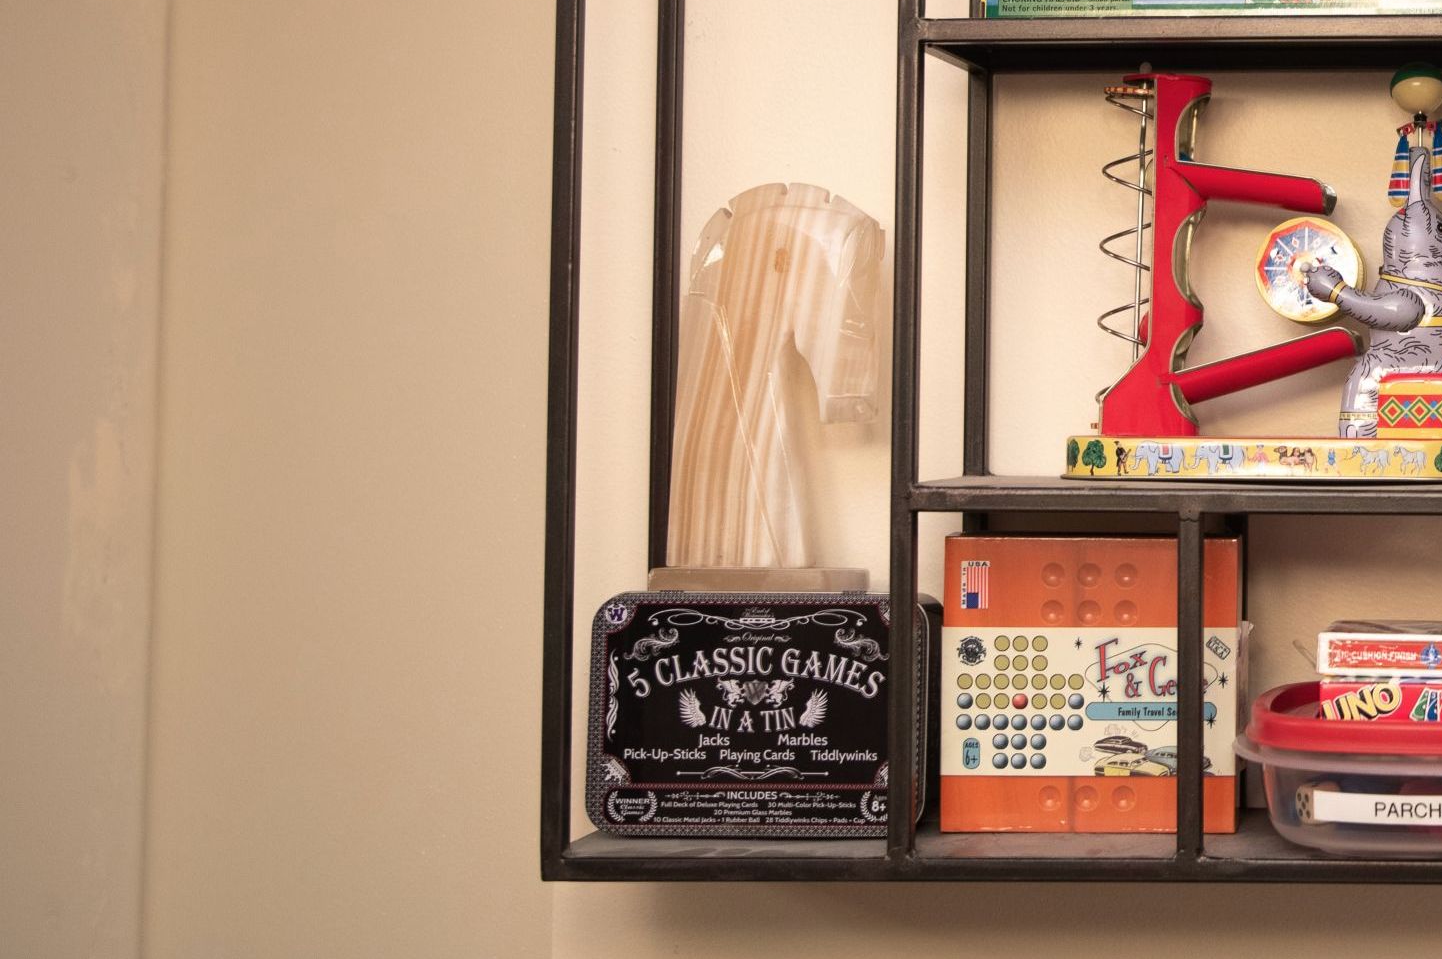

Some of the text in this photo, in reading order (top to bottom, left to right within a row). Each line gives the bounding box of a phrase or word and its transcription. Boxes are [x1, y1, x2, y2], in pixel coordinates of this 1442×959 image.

[1002, 4, 1016, 12] Not
[1018, 4, 1030, 12] for
[1032, 4, 1063, 12] children
[1065, 4, 1087, 12] under
[608, 607, 624, 622] W
[742, 631, 775, 644] Original
[1094, 638, 1148, 683] Fox
[626, 645, 887, 699] 5 CLASSIC GAMES
[1124, 672, 1142, 699] &
[1320, 682, 1401, 722] UNO
[709, 704, 797, 733] IN A TIN
[1117, 706, 1141, 719] Family
[1143, 706, 1165, 717] Travel
[698, 733, 730, 748] Jacks
[777, 733, 828, 747] Marbles
[623, 747, 707, 763] Pick-Up-Sticks
[719, 748, 796, 764] Playing Cards
[810, 749, 878, 764] Tiddlywinks
[965, 749, 978, 766] 6+
[726, 791, 778, 800] INCLUDES
[718, 801, 741, 809] Playing
[871, 800, 887, 812] 8+
